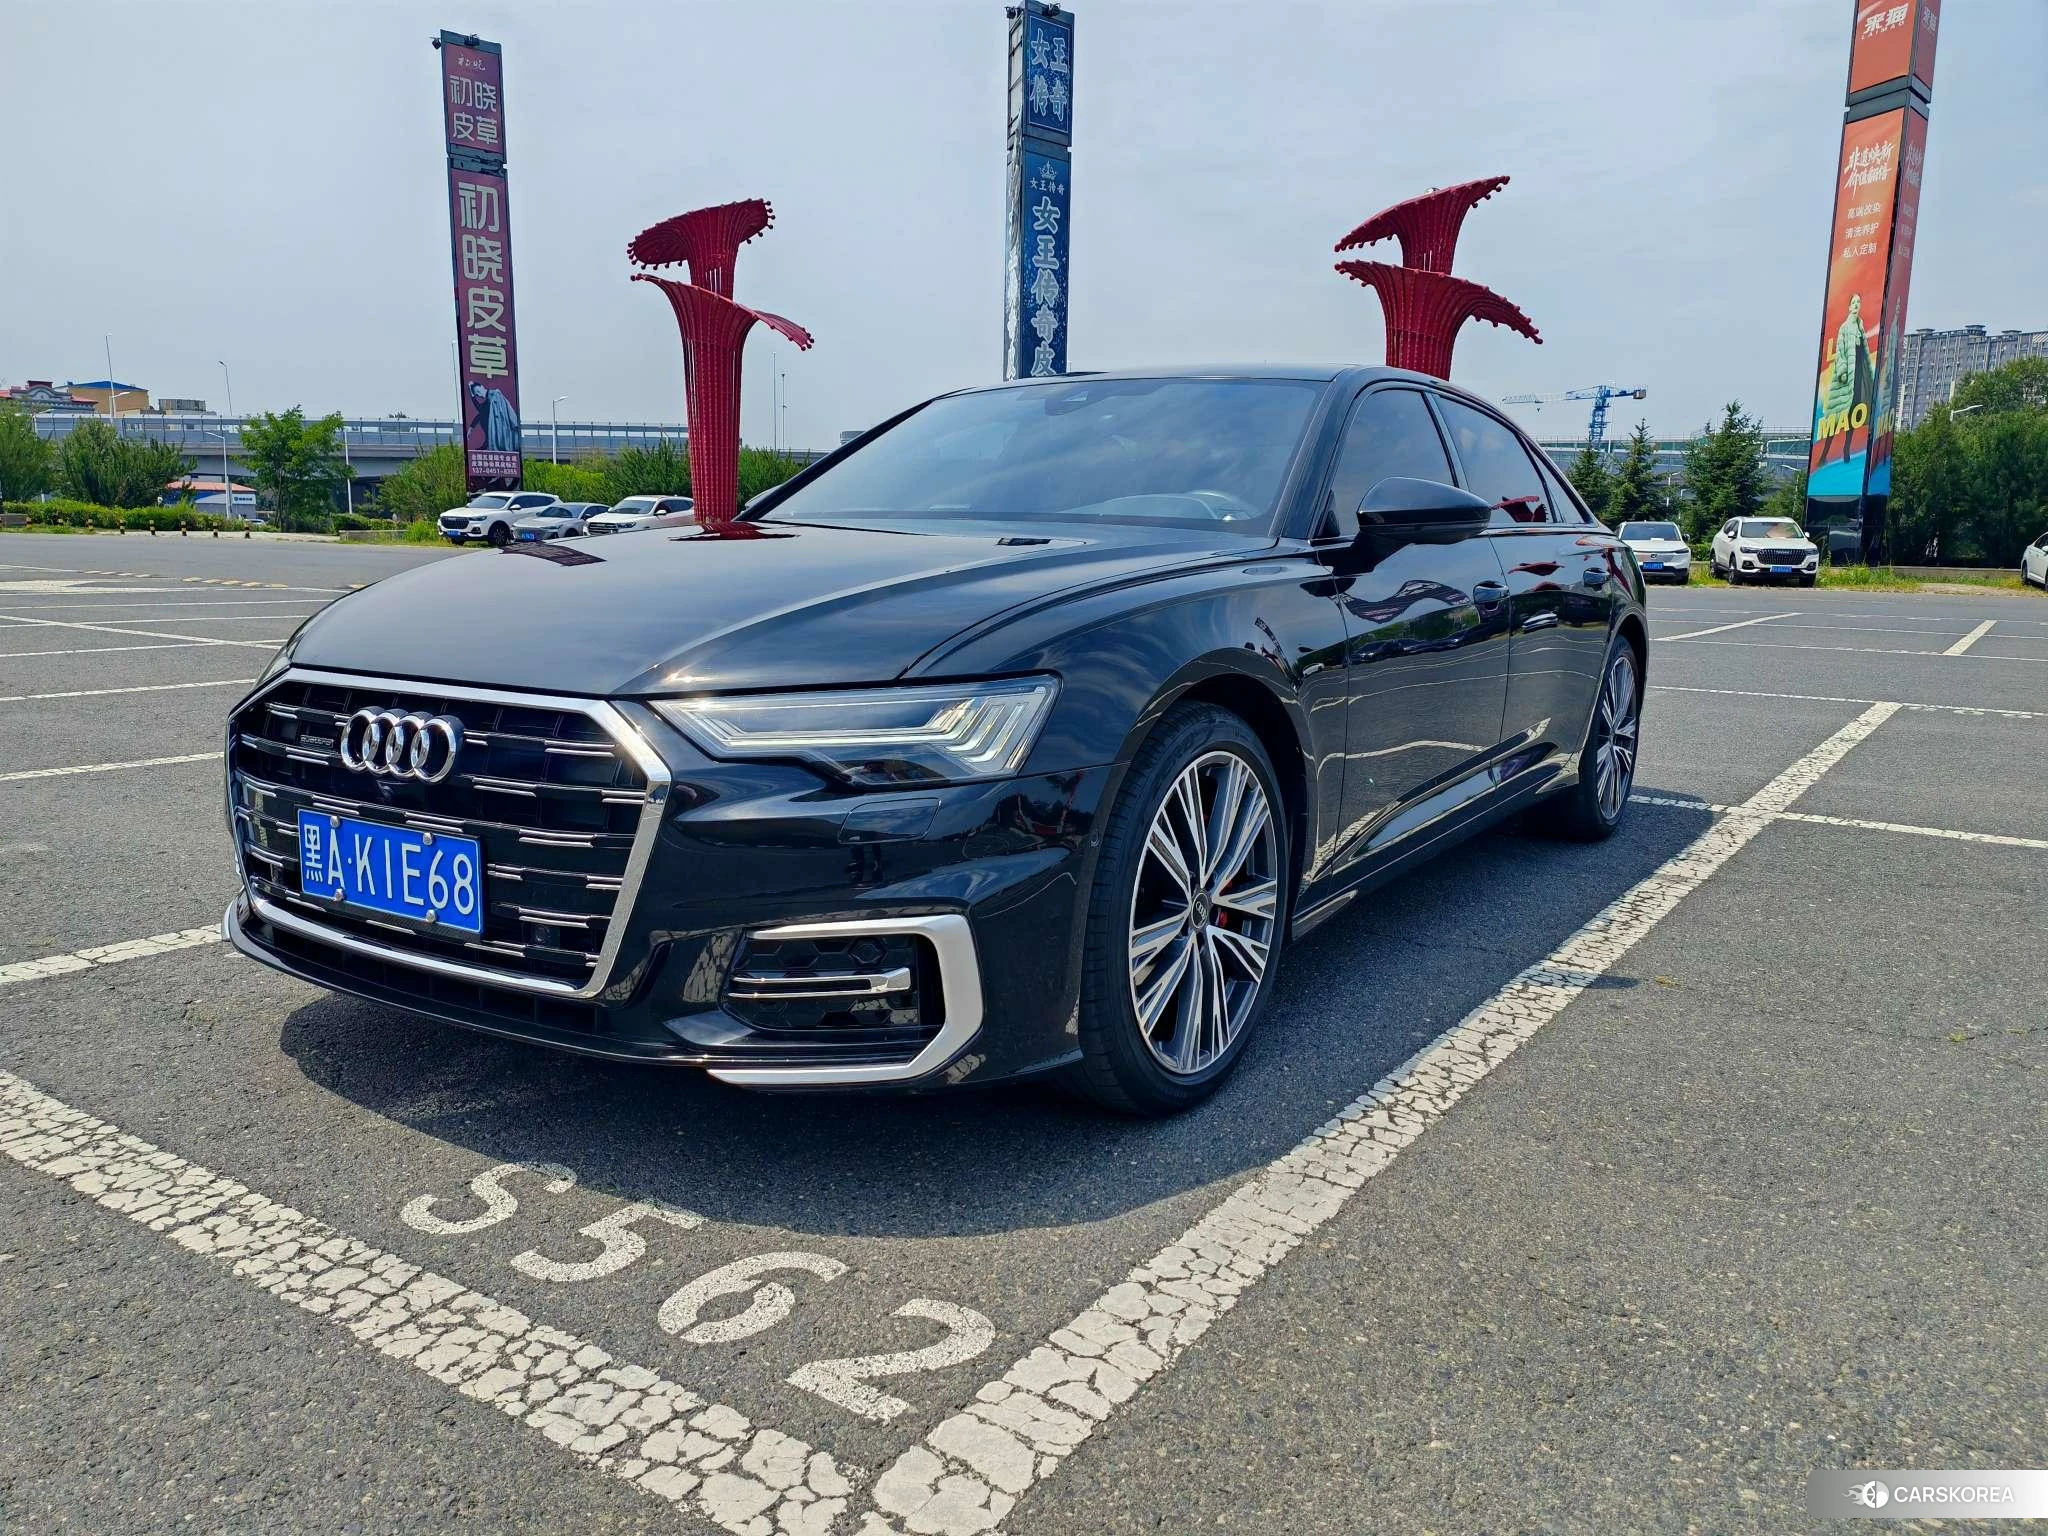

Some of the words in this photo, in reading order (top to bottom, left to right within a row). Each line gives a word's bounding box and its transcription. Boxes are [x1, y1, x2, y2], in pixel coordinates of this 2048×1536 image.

[1030, 28, 1069, 73] 女王
[448, 74, 498, 112] 初晓
[1030, 74, 1067, 122] 传奇
[453, 111, 498, 145] 皮草
[1029, 177, 1065, 196] 女王传奇
[458, 181, 509, 379] 初晓皮草
[1816, 403, 1868, 440] MAO
